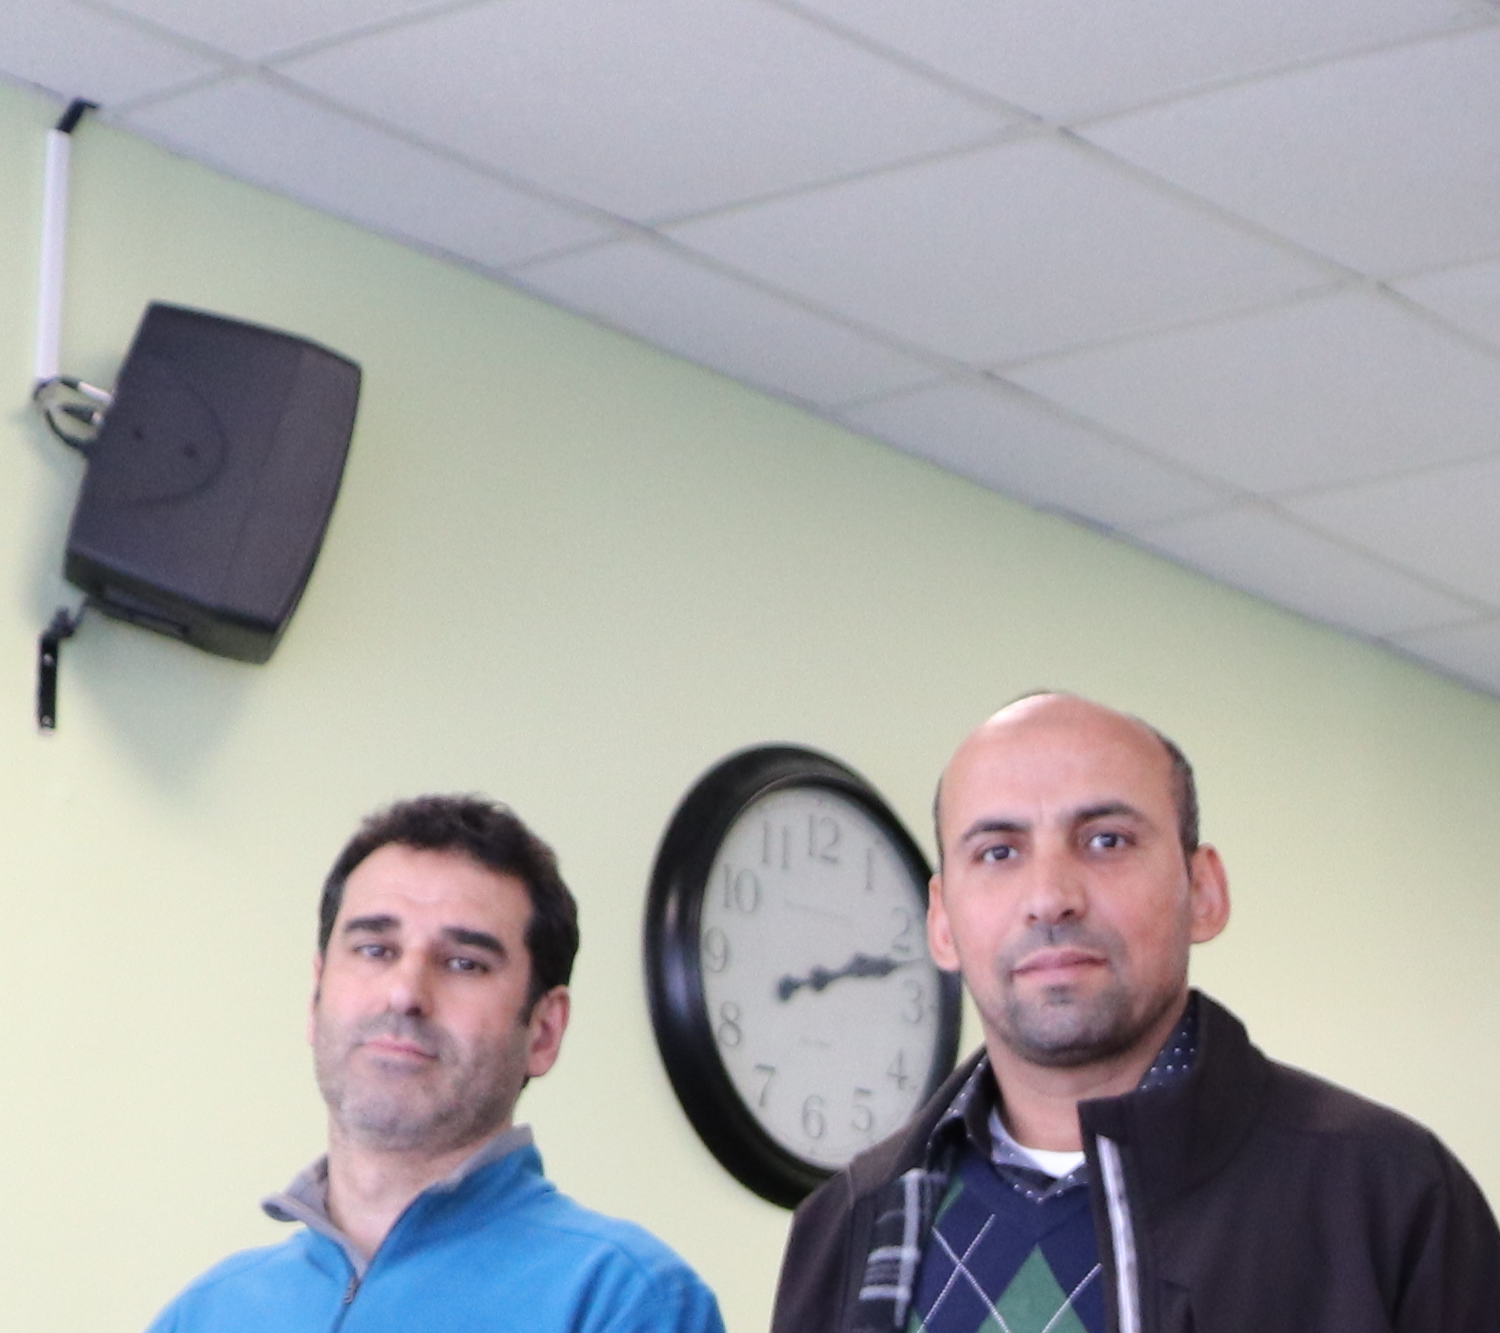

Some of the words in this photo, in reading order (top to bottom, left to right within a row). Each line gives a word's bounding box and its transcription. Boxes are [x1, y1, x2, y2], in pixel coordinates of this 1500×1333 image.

[761, 820, 791, 870] 11
[806, 813, 842, 863] 12
[723, 864, 760, 914] 10
[864, 847, 875, 891] 1
[704, 926, 729, 973] 9
[891, 906, 913, 953] 2
[904, 978, 924, 1024] 3
[717, 1002, 742, 1048] 8
[753, 1063, 777, 1108] 7
[886, 1052, 908, 1091] 4
[802, 1094, 825, 1140] 6
[851, 1086, 873, 1132] 5
